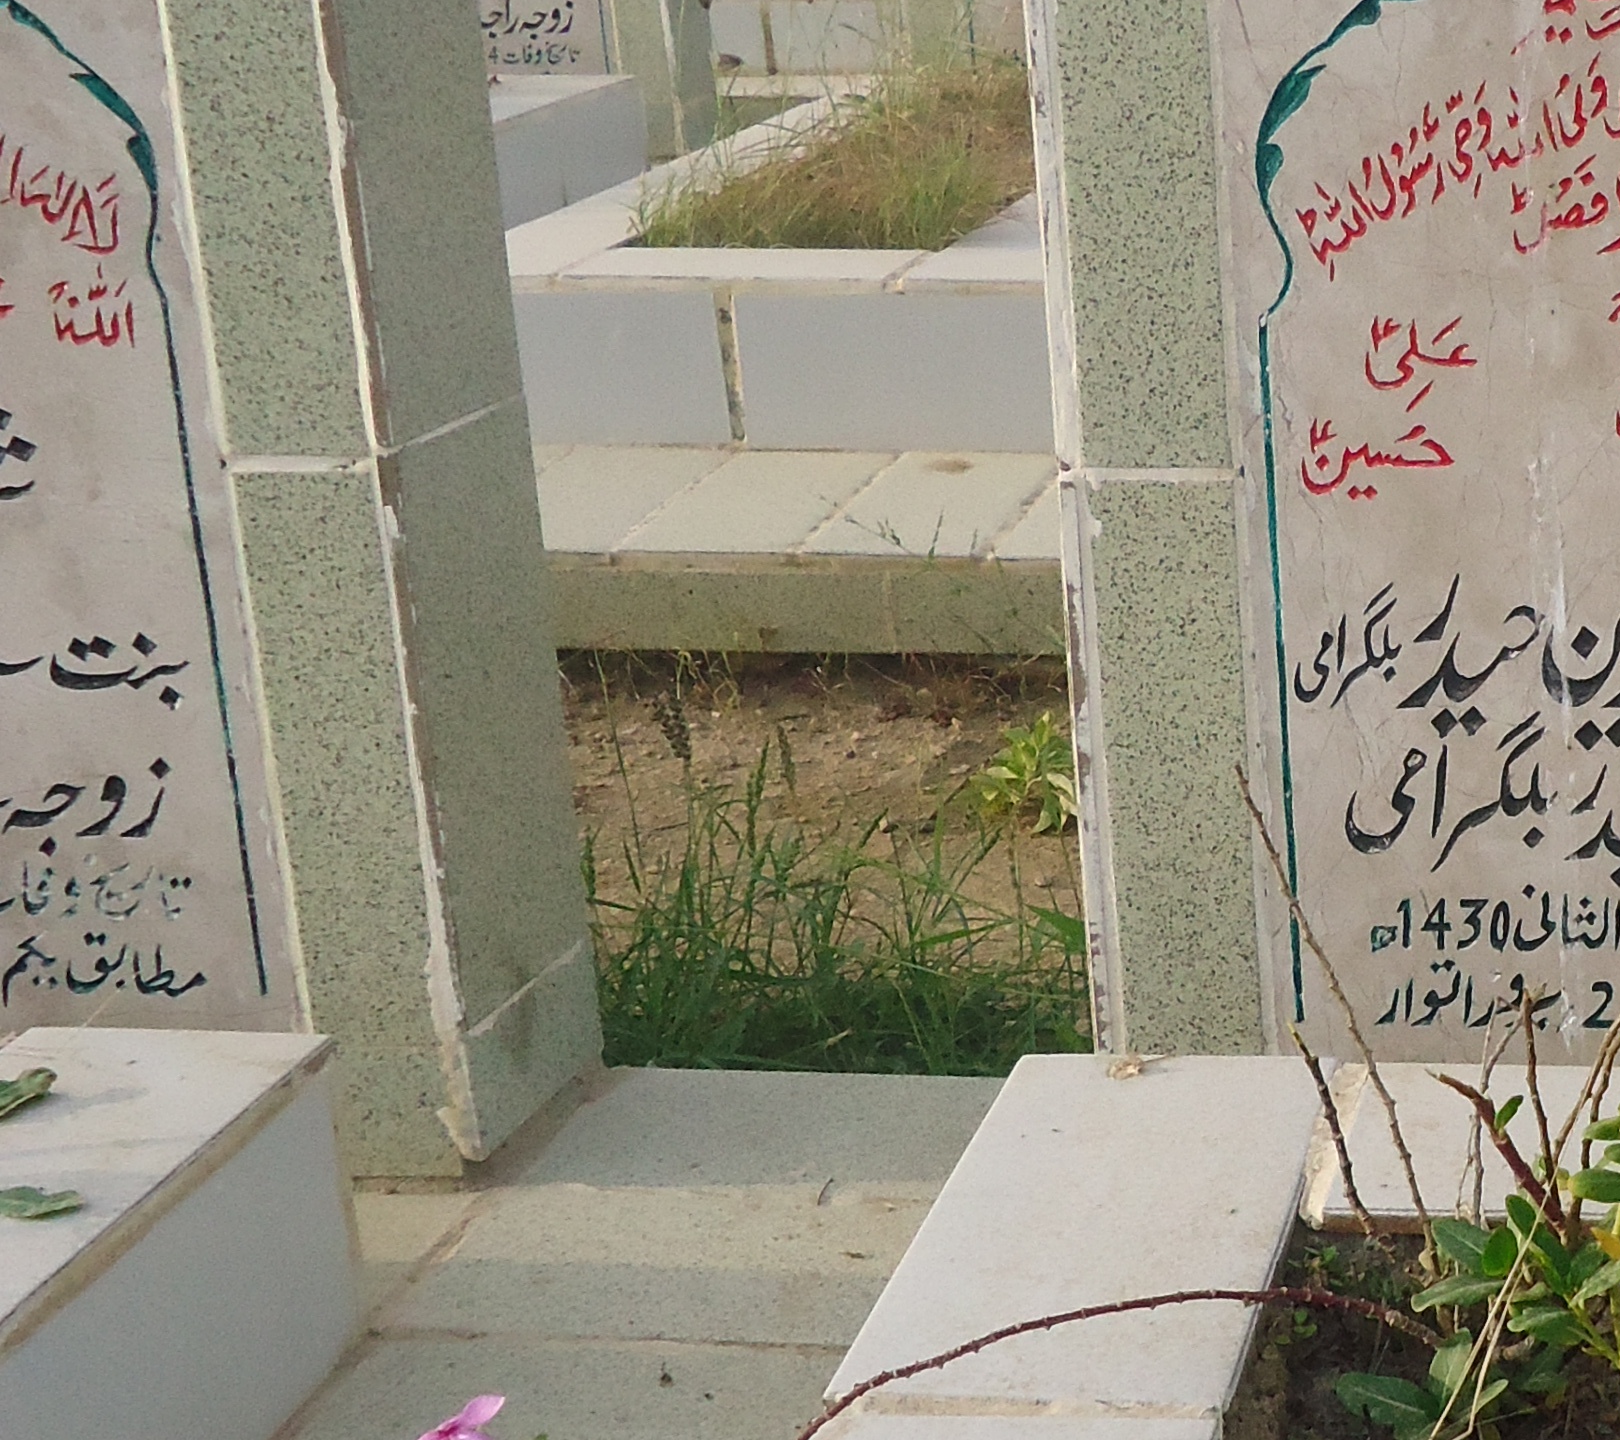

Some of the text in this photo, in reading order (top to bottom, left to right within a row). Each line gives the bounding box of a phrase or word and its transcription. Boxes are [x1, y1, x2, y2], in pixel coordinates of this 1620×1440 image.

[49, 631, 191, 711] بنت
[1396, 572, 1548, 739] حیدر
[66, 931, 208, 998] مطابق
